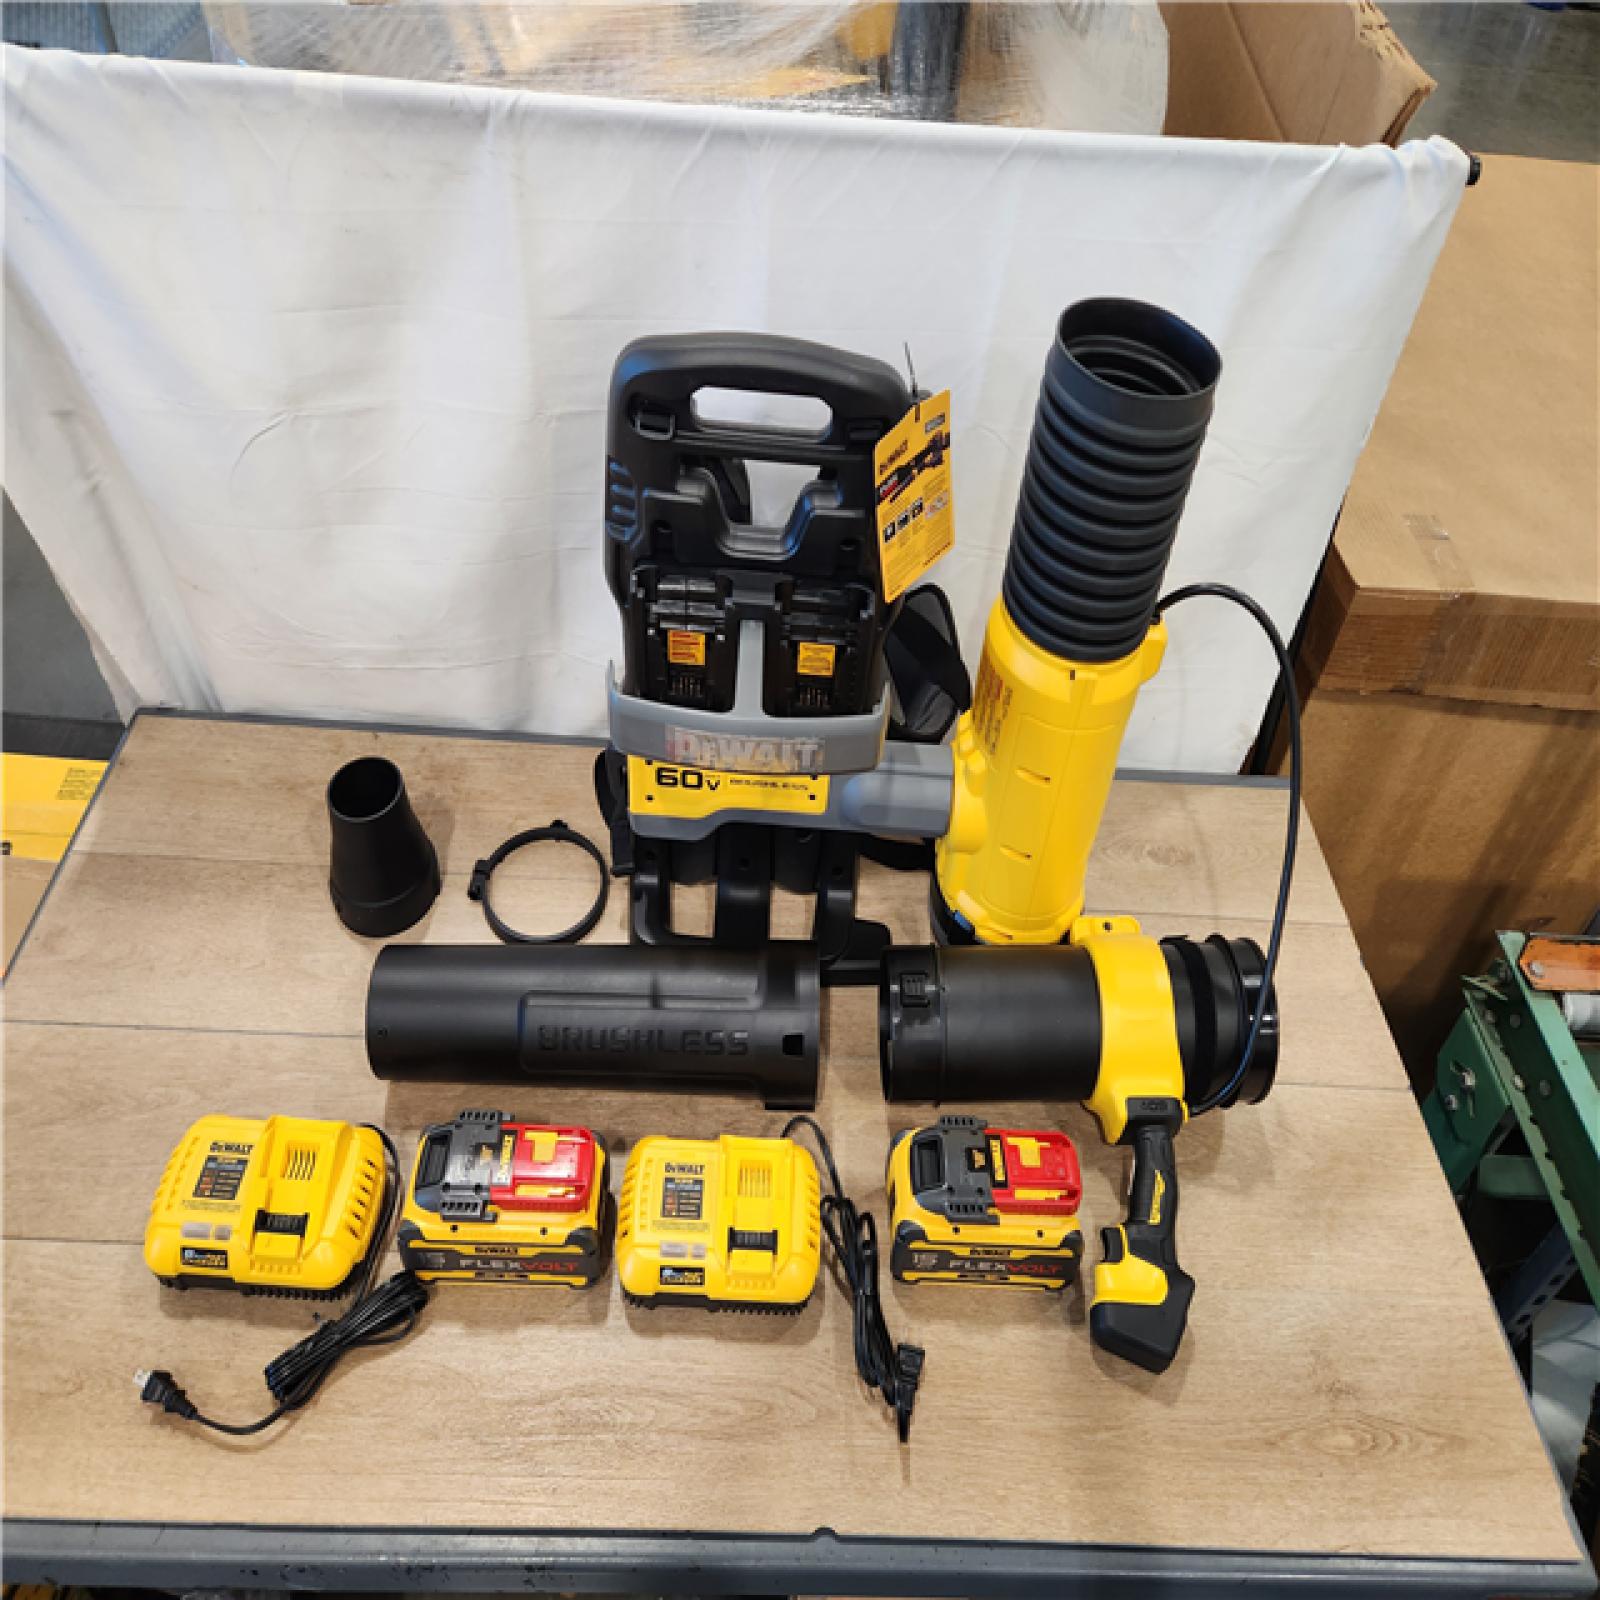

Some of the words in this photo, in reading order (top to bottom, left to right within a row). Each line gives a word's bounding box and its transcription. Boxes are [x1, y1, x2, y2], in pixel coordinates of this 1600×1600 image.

[538, 1025, 749, 1055] BRUSHLESS
[459, 1258, 578, 1272] FLEXVOLT
[949, 1259, 1065, 1274] FLEXVOLT
